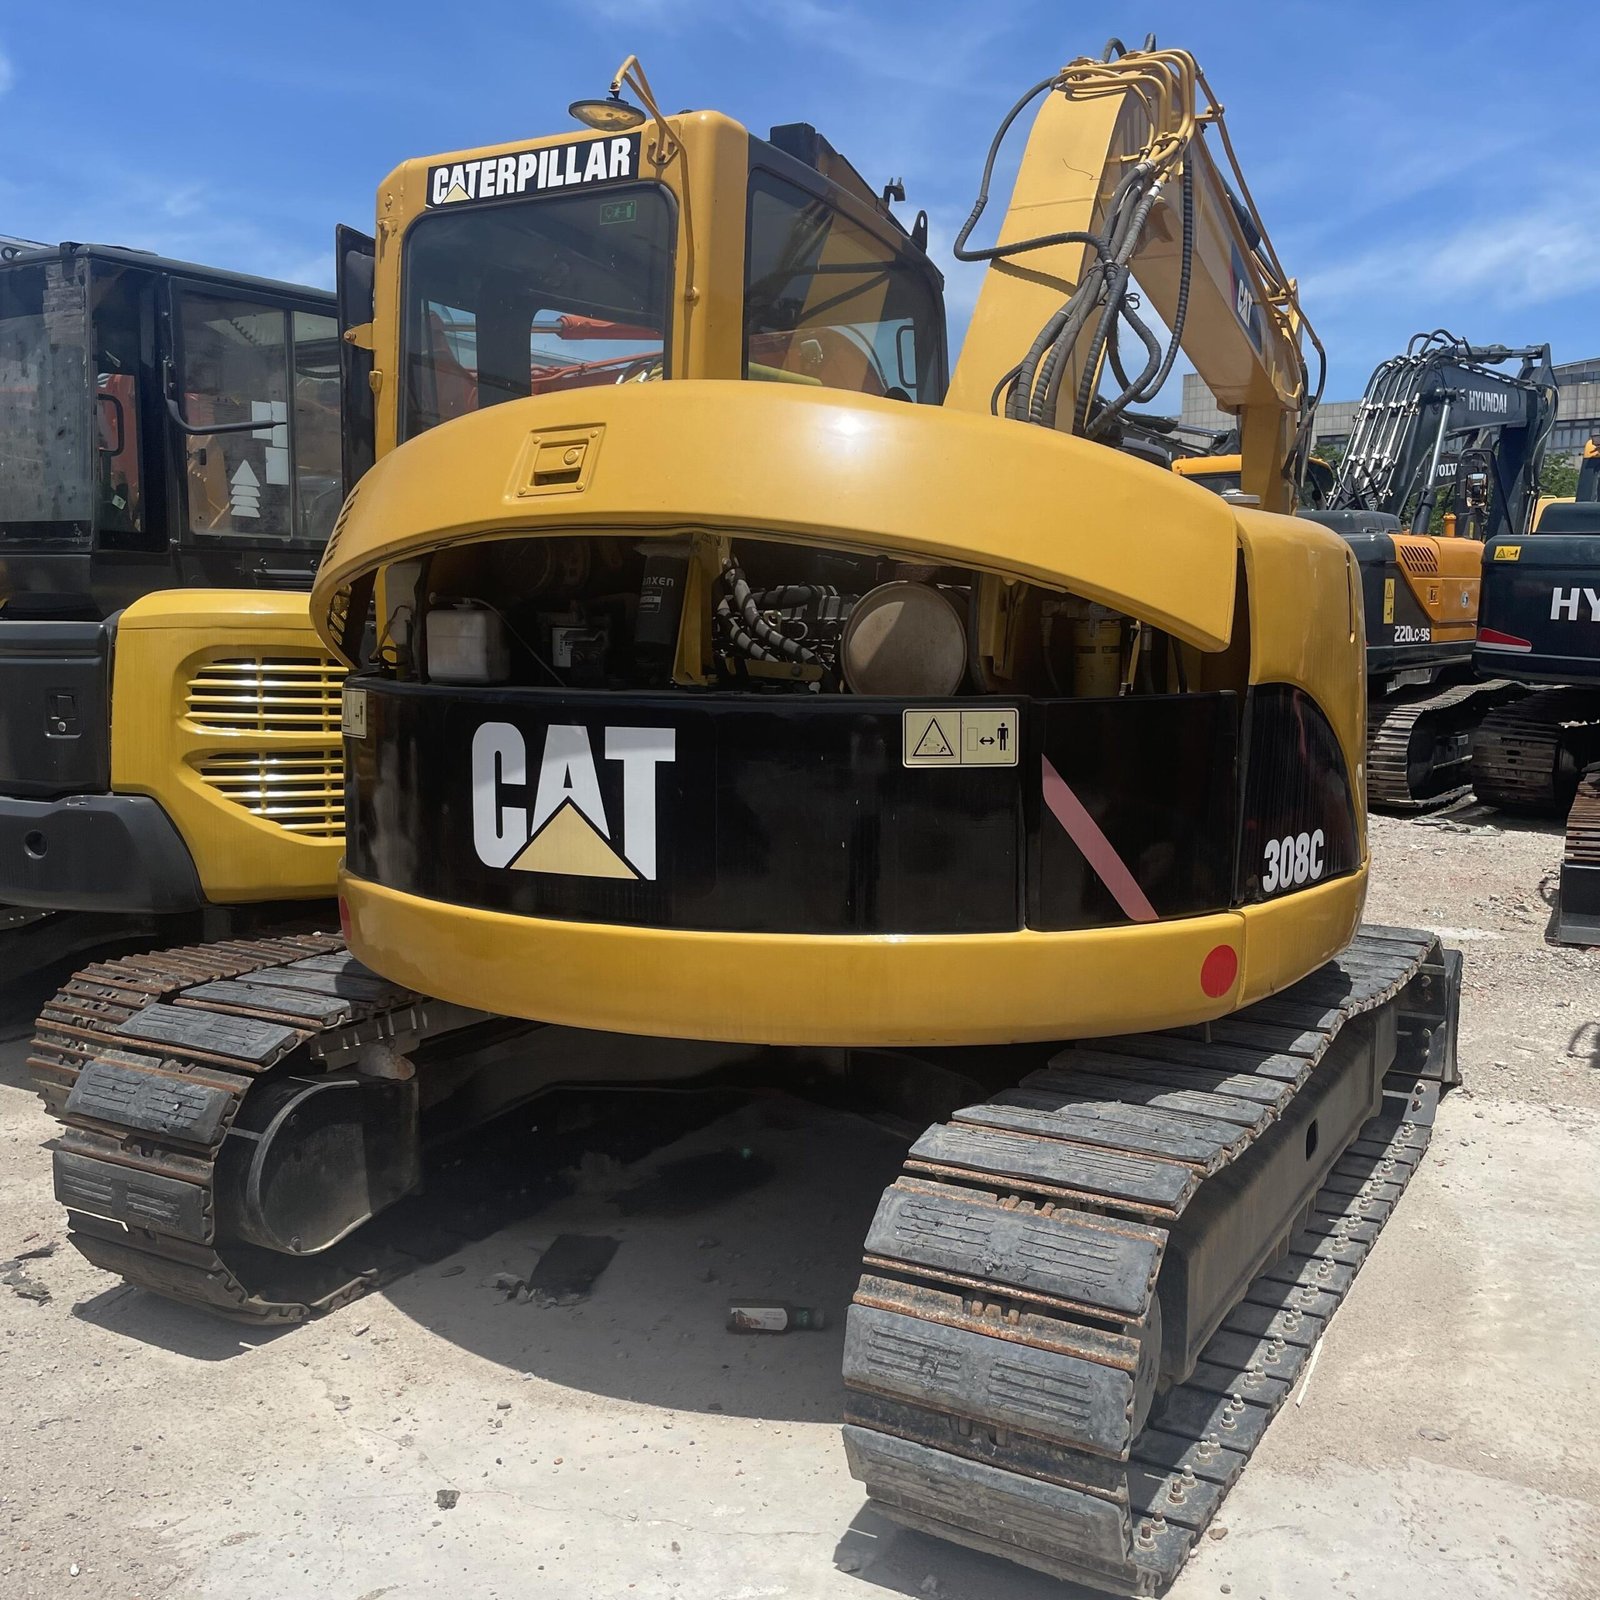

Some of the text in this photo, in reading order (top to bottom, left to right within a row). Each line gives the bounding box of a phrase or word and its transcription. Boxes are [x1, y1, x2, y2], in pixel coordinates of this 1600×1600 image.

[432, 137, 631, 205] CATERPILLAR
[1237, 279, 1253, 329] CAT
[1468, 390, 1507, 414] HYUNDAI
[1550, 587, 1600, 622] HY
[1394, 625, 1430, 643] 220LC-9S
[472, 721, 676, 881] CAT
[1262, 828, 1324, 893] 308C
